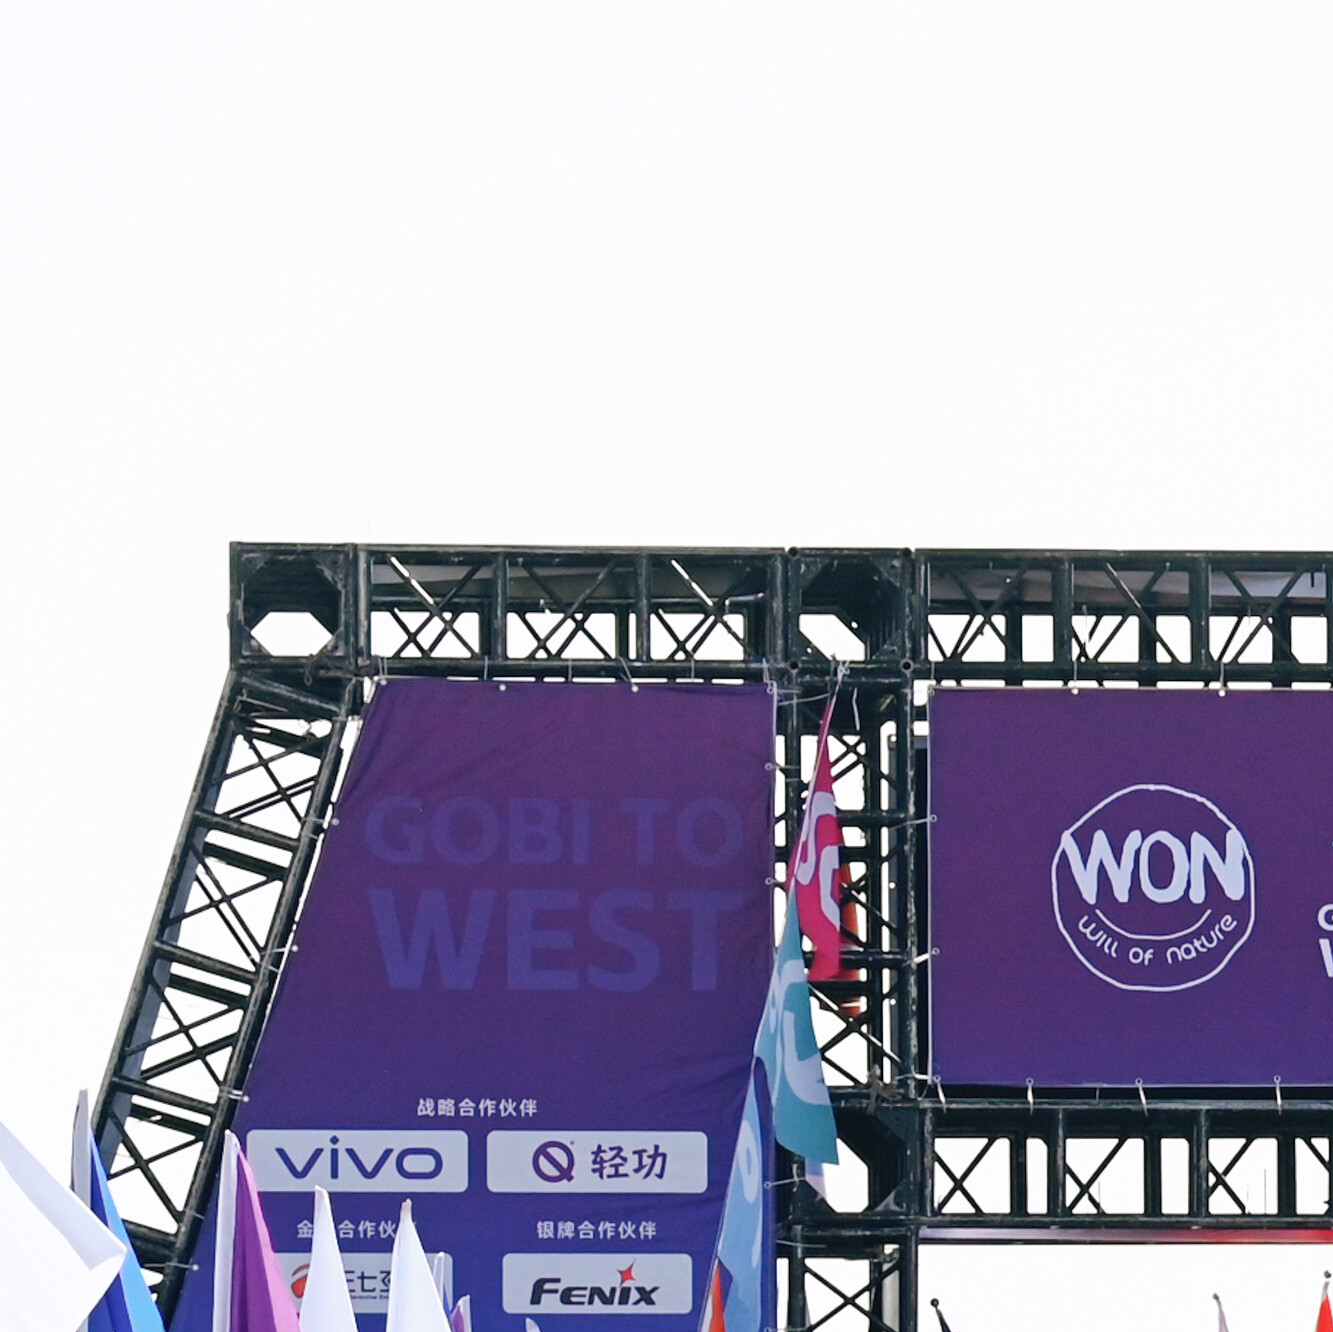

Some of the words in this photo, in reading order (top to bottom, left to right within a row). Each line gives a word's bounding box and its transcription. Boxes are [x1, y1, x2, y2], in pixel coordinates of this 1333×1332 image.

[364, 795, 589, 868] GOBI
[616, 795, 744, 866] TO
[1061, 829, 1246, 905] WON
[366, 886, 742, 993] WEST
[1128, 944, 1155, 967] of
[1165, 913, 1238, 965] nature
[416, 1098, 538, 1118] 战略合作伙伴
[274, 1135, 444, 1181] vivo
[590, 1143, 669, 1181] 轻功
[297, 1220, 417, 1239] 金合作伙
[536, 1220, 658, 1240] 银牌合作伙伴
